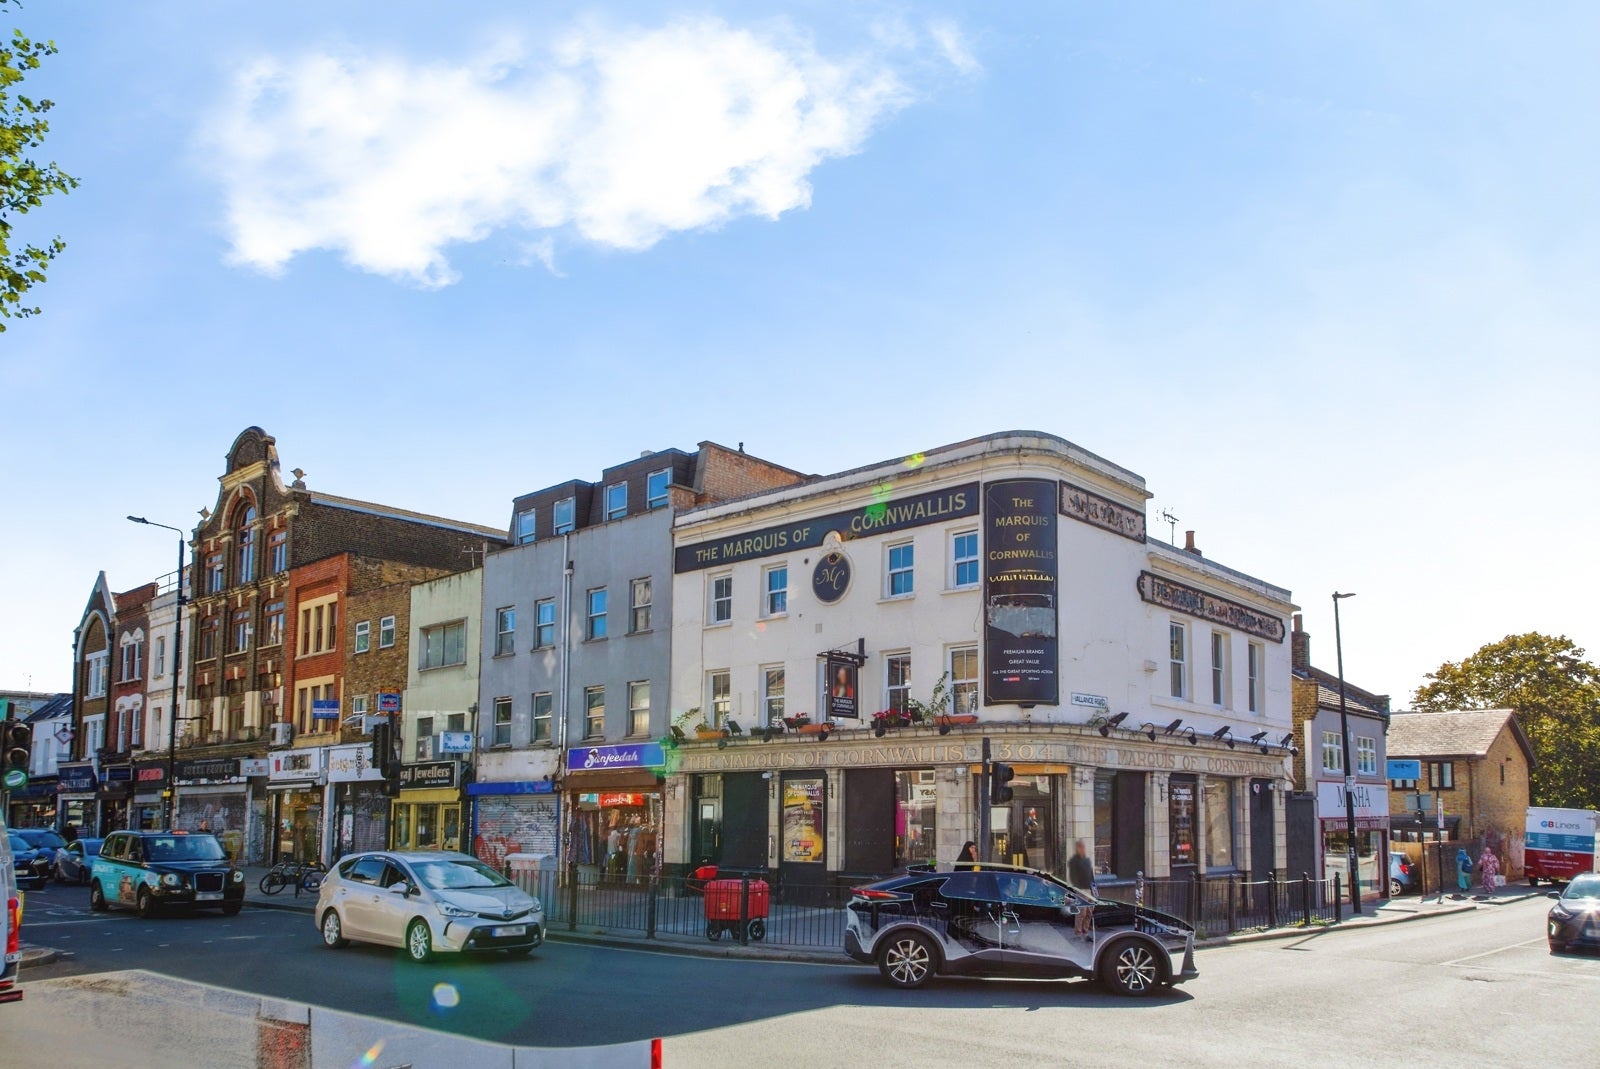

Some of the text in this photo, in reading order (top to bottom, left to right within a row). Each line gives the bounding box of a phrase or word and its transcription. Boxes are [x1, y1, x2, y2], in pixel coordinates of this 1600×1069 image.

[1012, 498, 1034, 508] THE
[696, 493, 967, 562] THE MARQUIS OF CORNWALLIS
[995, 515, 1049, 528] MARQUIS
[1016, 533, 1031, 542] OF
[990, 549, 1055, 561] CORNWALLIS
[689, 745, 964, 770] THE MARQUIS OF CORNWALLIS
[999, 745, 1052, 760] 304
[1117, 751, 1176, 769] MARQUIS
[1182, 754, 1200, 770] OF
[1207, 757, 1275, 777] CORNWALLIS
[414, 766, 450, 782] Jewellers
[1336, 786, 1371, 808] MSHA
[1540, 820, 1580, 830] GB Liners
